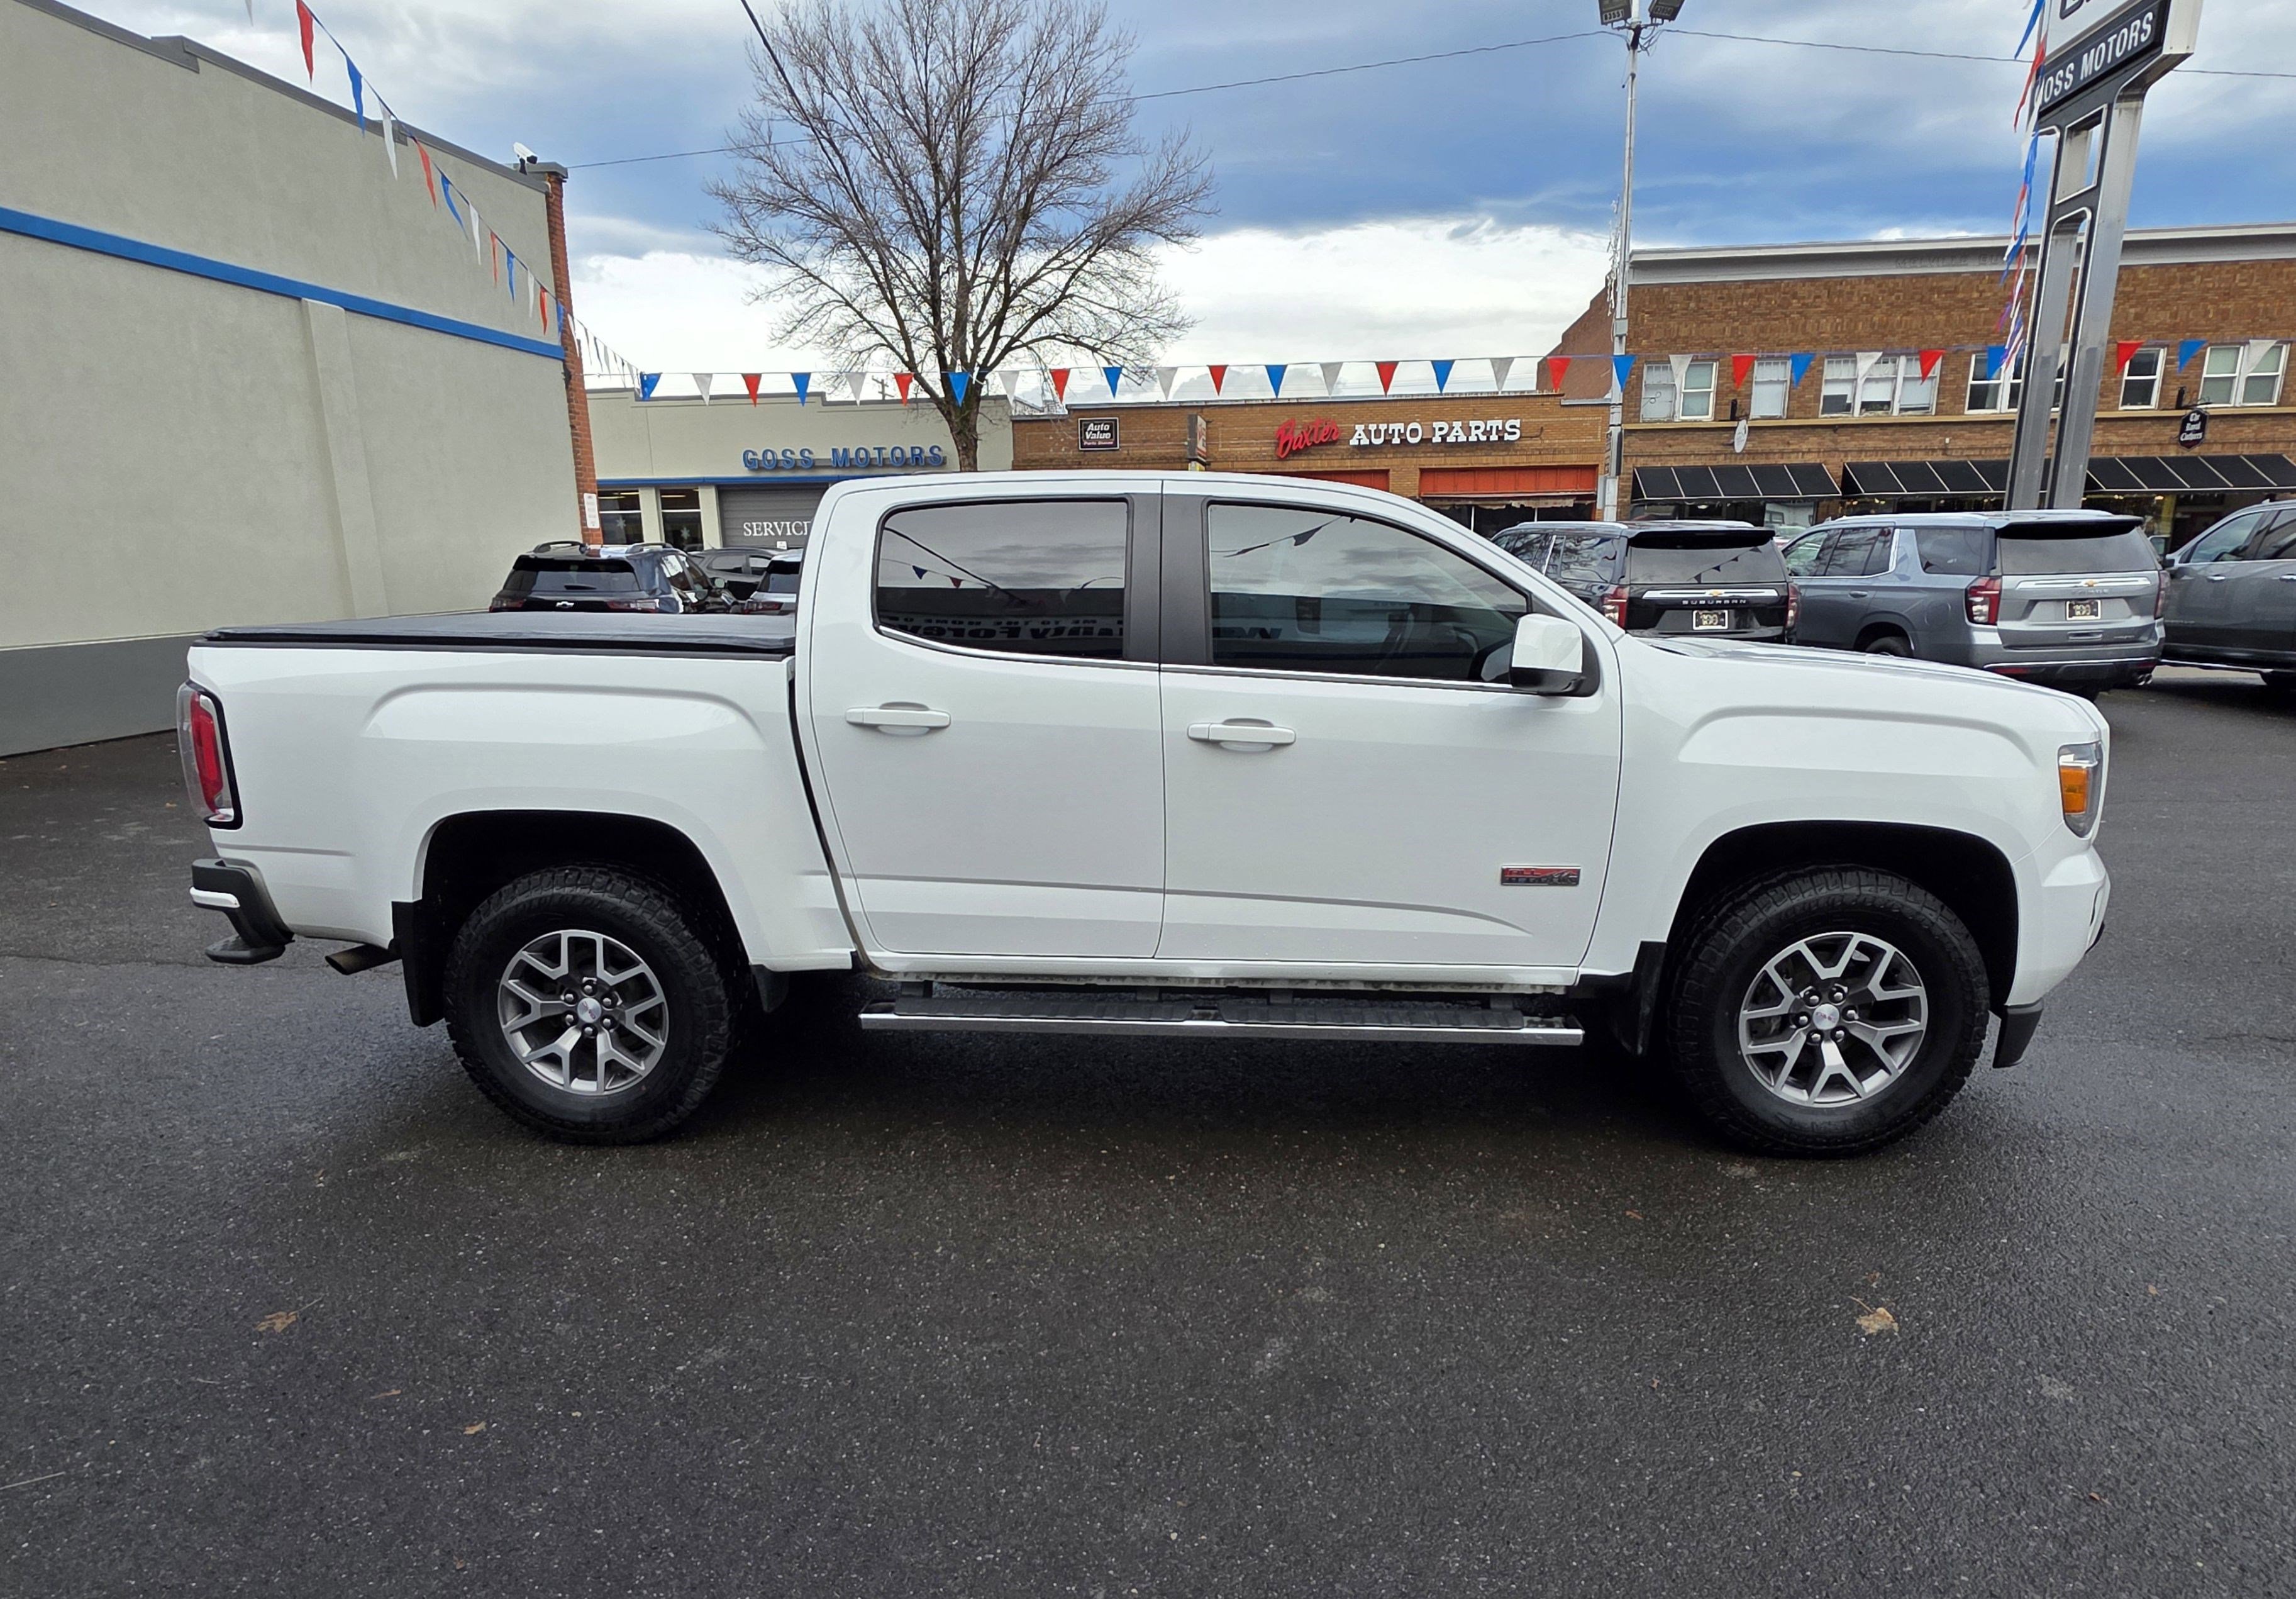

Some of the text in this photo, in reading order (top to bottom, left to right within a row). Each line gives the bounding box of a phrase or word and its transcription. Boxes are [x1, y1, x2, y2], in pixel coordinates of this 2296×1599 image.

[2080, 11, 2153, 81] MOTORS
[1087, 423, 1110, 432] Auto
[1275, 417, 1521, 459] Baxter AUTO PARTS
[743, 445, 944, 471] GOSS MOTORS
